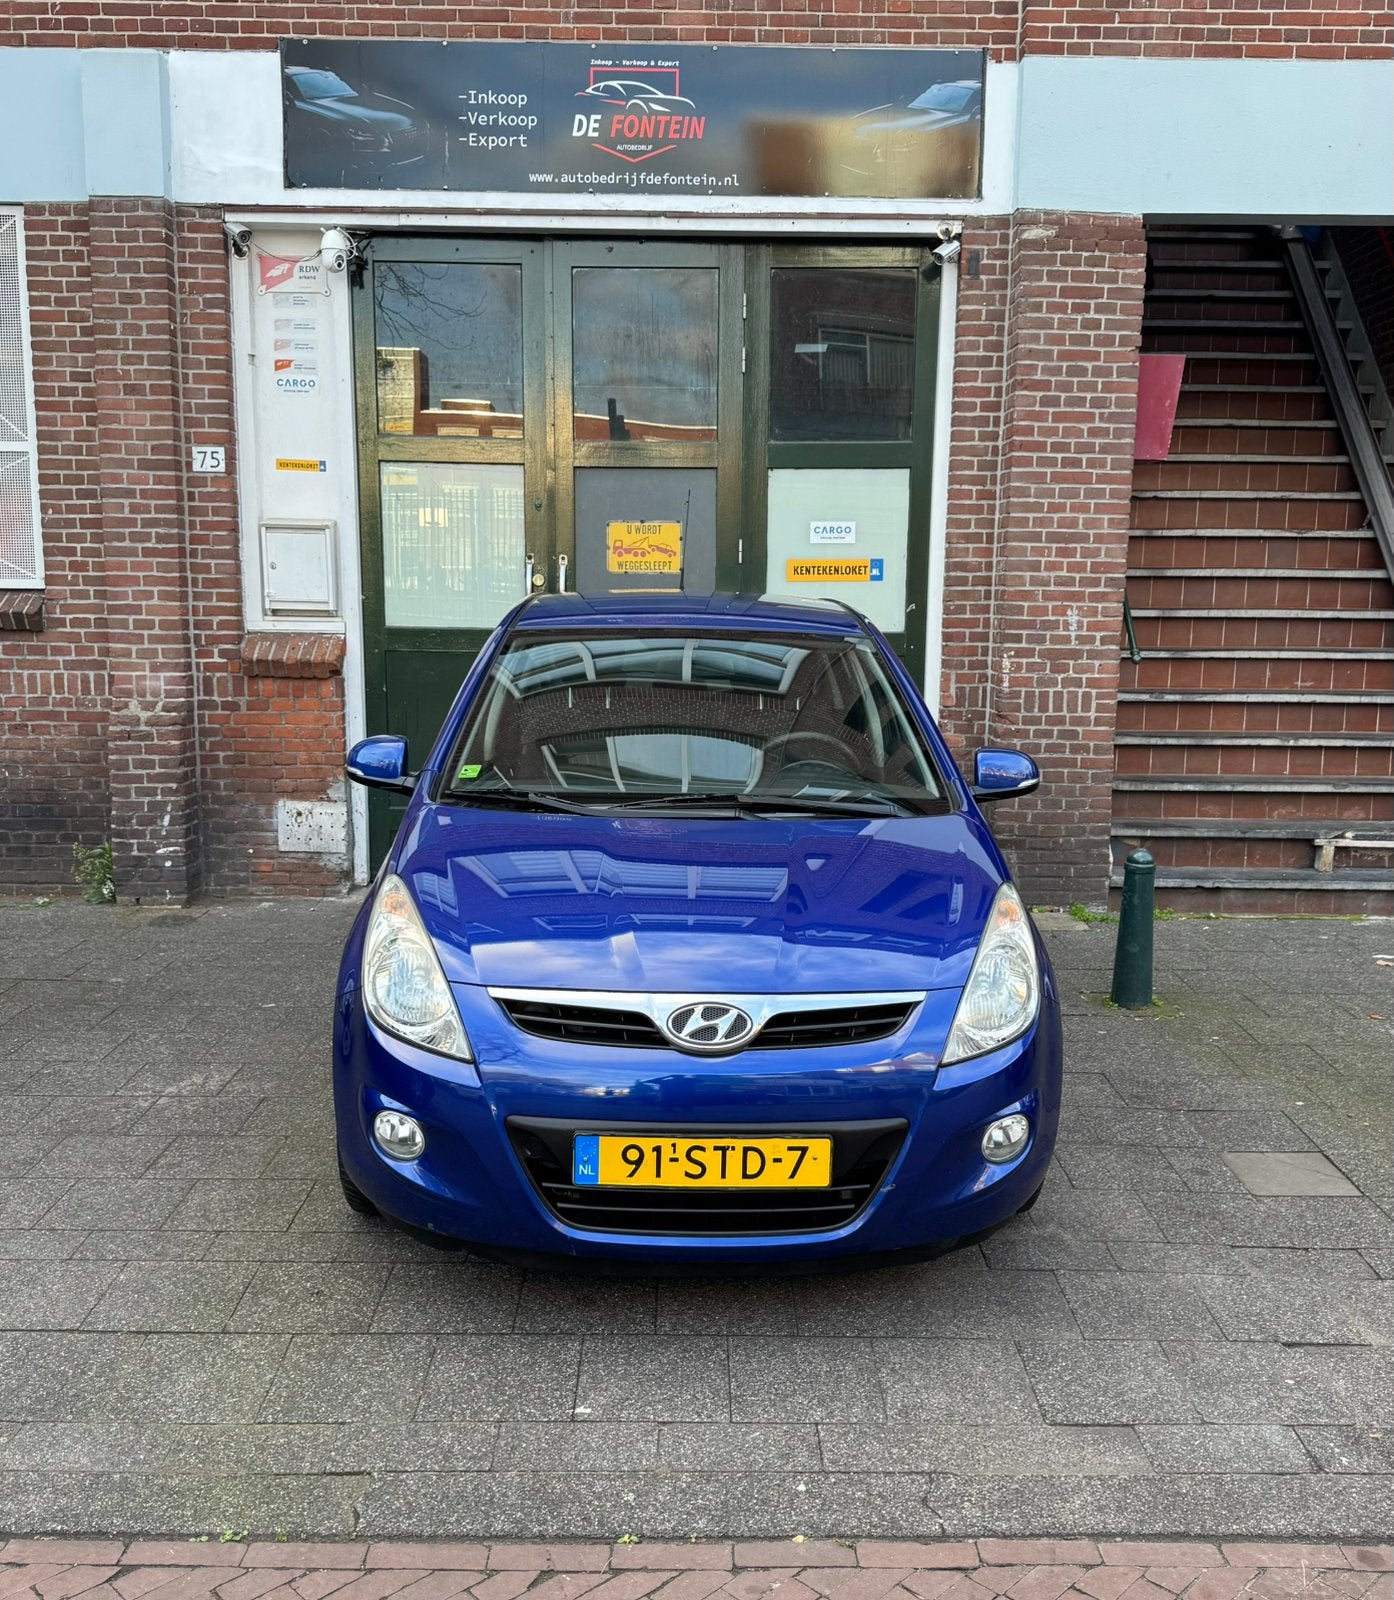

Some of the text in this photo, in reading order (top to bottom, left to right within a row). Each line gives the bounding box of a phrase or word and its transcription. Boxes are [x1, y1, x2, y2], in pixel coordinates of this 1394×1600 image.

[622, 59, 648, 67] Verkoop
[459, 90, 528, 108] -Inkoop
[459, 111, 538, 130] -Verkoop
[572, 114, 706, 139] DE FONTEIN
[459, 133, 528, 150] -Export
[529, 172, 740, 187] www.autobedrijfdefontein.nl
[298, 265, 321, 273] RDW
[276, 378, 316, 388] CARGO
[197, 451, 220, 468] 75
[626, 524, 662, 536] U WORDT
[813, 526, 852, 535] CARGO
[617, 560, 672, 571] WEGGESLEEPT
[578, 1143, 809, 1180] NL 91-STD-7
